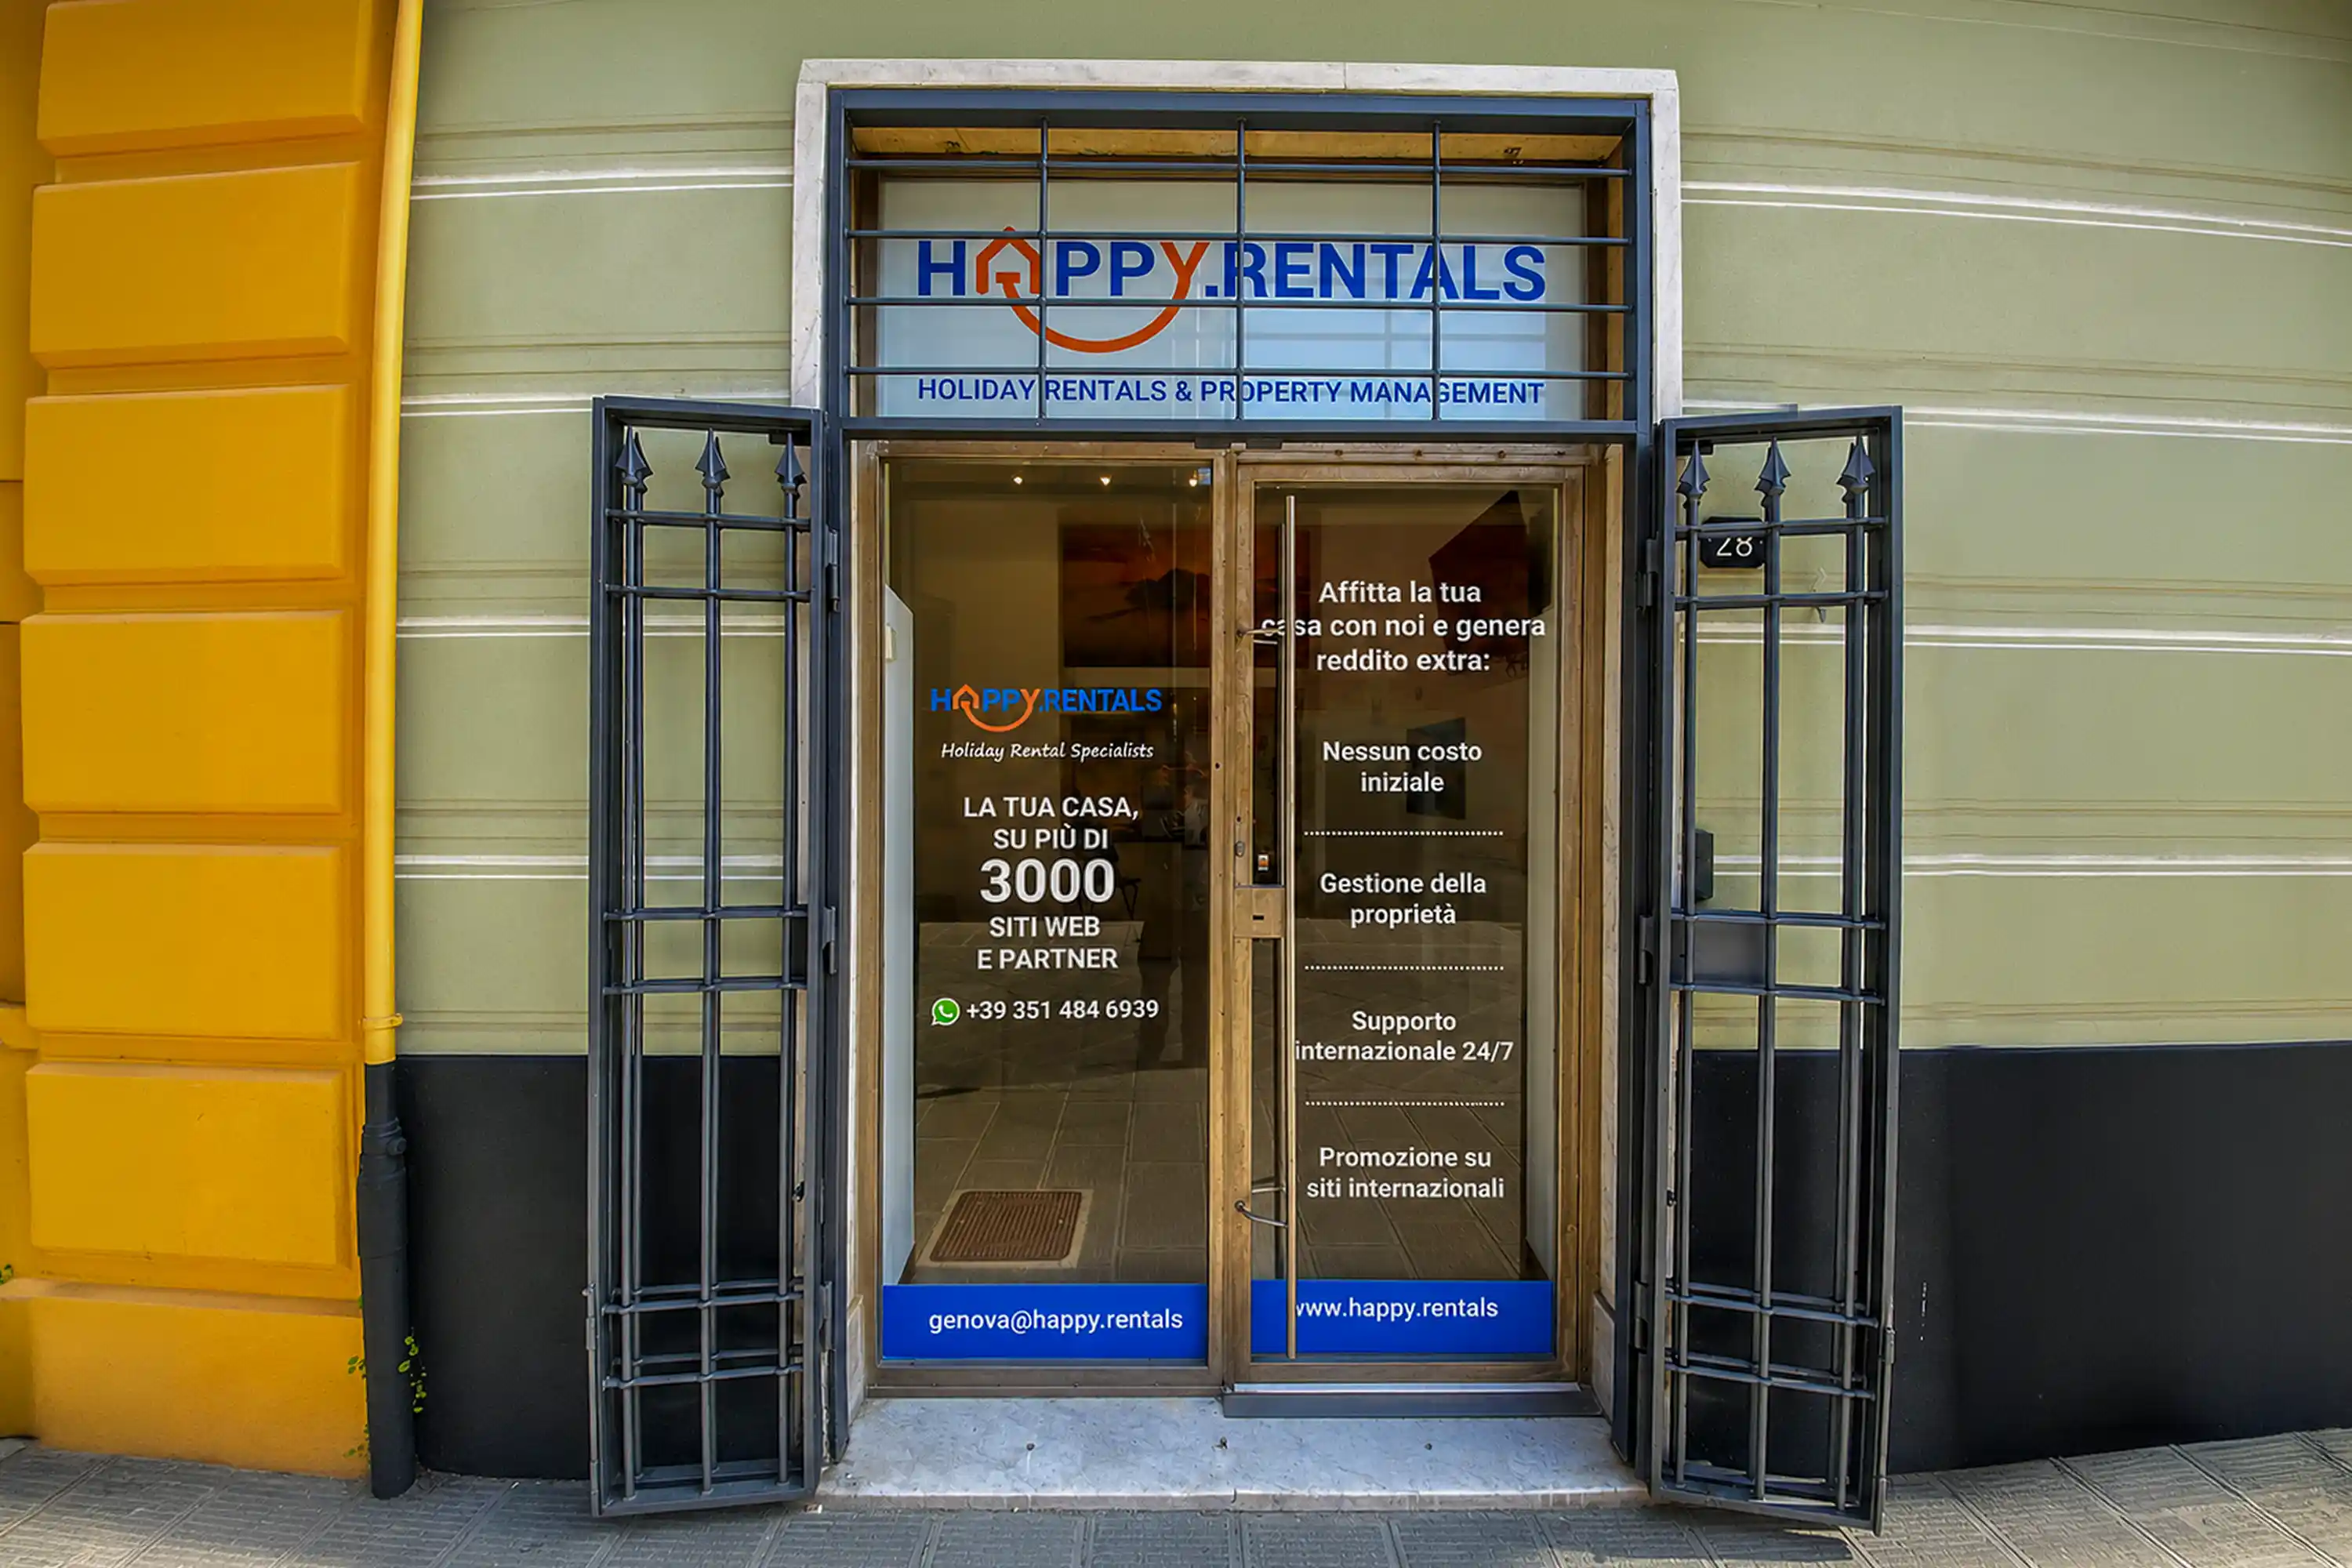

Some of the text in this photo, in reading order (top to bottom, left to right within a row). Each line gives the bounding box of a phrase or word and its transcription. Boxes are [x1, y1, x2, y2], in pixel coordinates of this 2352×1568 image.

[917, 378, 1545, 405] HOLIDAY RENTALS & PROPERTY MANAGEMENT
[1319, 580, 1482, 603] Affitta la tua
[1330, 619, 1377, 637] con
[1385, 613, 1425, 637] noi
[1432, 619, 1449, 637] e
[1455, 619, 1547, 642] genera
[1316, 648, 1490, 672] reddito extra:
[941, 741, 1154, 763] Holiday Rental Specialists
[1323, 741, 1483, 761] Nessun costo
[1360, 771, 1445, 793] iniziale
[964, 796, 1139, 821] LA TUA CASA,
[993, 822, 1109, 850] SU PIÙ DI
[979, 858, 1115, 903] 3000
[1319, 871, 1486, 894] Gestione della
[989, 916, 1101, 938] SITI WEB
[1350, 902, 1457, 929] proprietà
[977, 947, 1119, 970] E PARTNER
[965, 999, 1160, 1020] +39 351 484 6939
[1352, 1010, 1457, 1035] Supporto
[1295, 1040, 1515, 1063] internazionale 24/7
[1319, 1145, 1492, 1168] Promozione su
[1306, 1176, 1504, 1199] siti internazionali
[928, 1307, 1184, 1335] genova@happy.rentals
